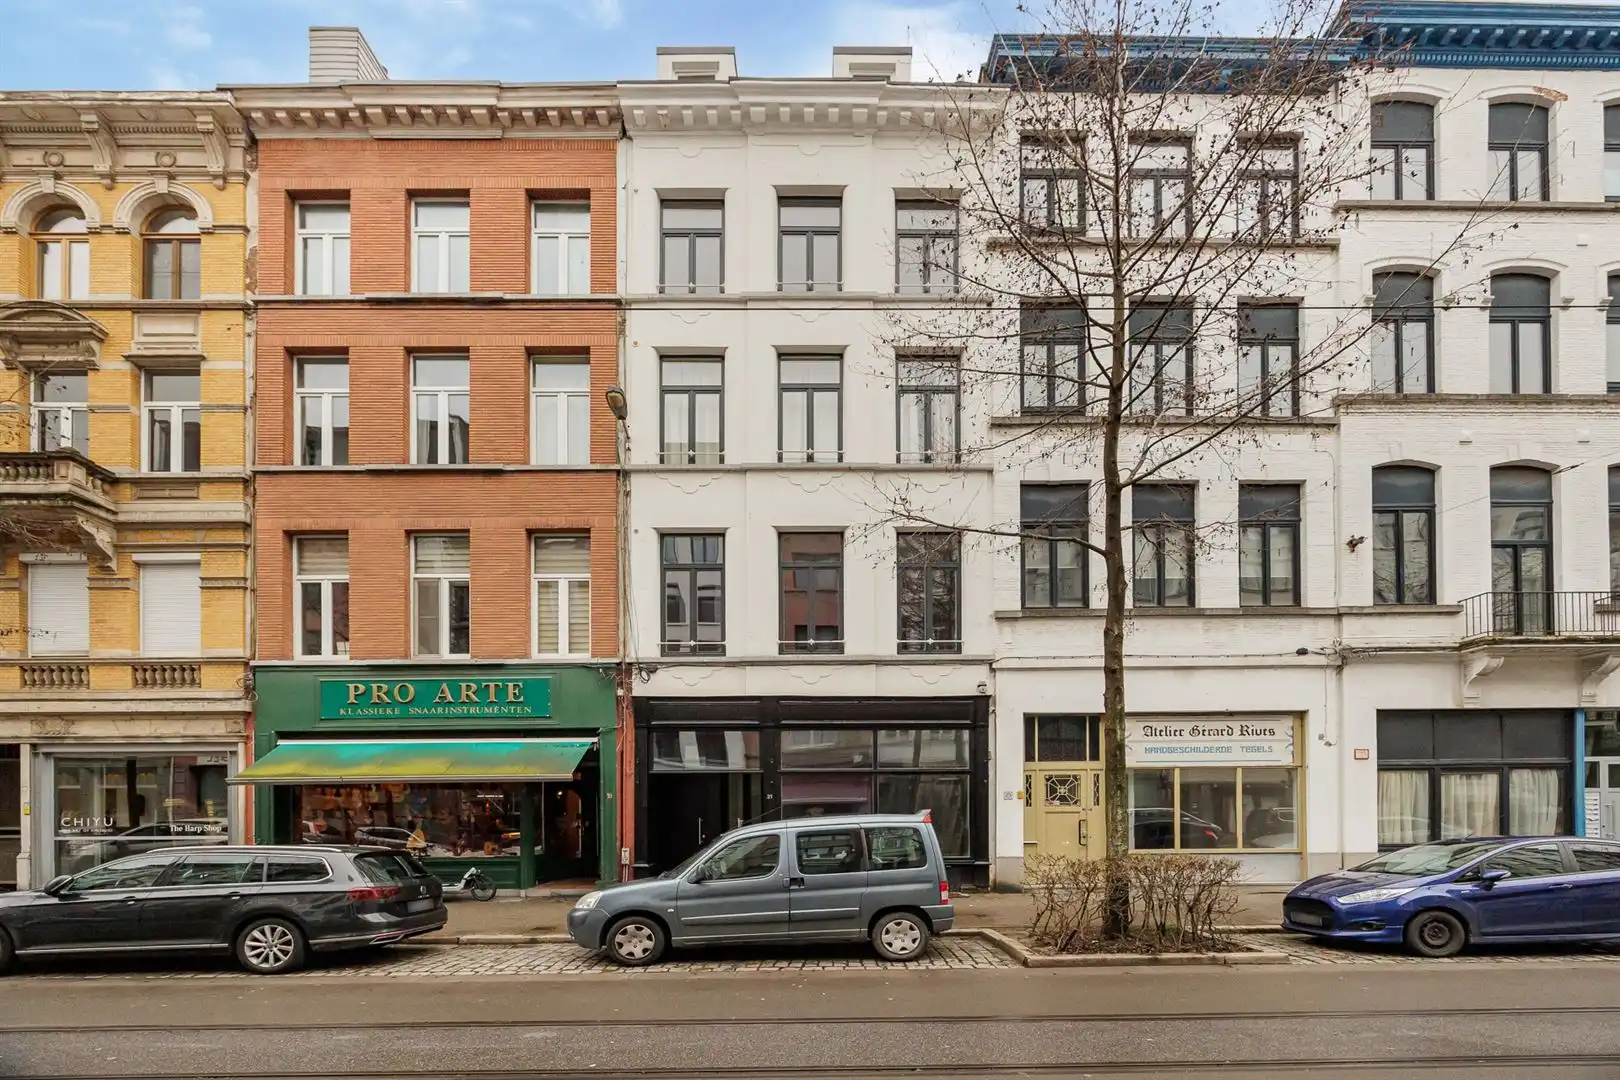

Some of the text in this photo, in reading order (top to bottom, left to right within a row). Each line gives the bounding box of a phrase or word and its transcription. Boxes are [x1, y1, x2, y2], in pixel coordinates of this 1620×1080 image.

[346, 682, 524, 704] PRO ARTE
[339, 706, 532, 715] KLASSIEKE SNAARINSTRUMENTEN
[1142, 724, 1276, 737] Atelier Gérard Rives
[1144, 745, 1273, 755] HANDGESCHILDERDE TEGELS
[61, 817, 113, 827] CHIYU
[169, 824, 222, 834] The Harp Shop
